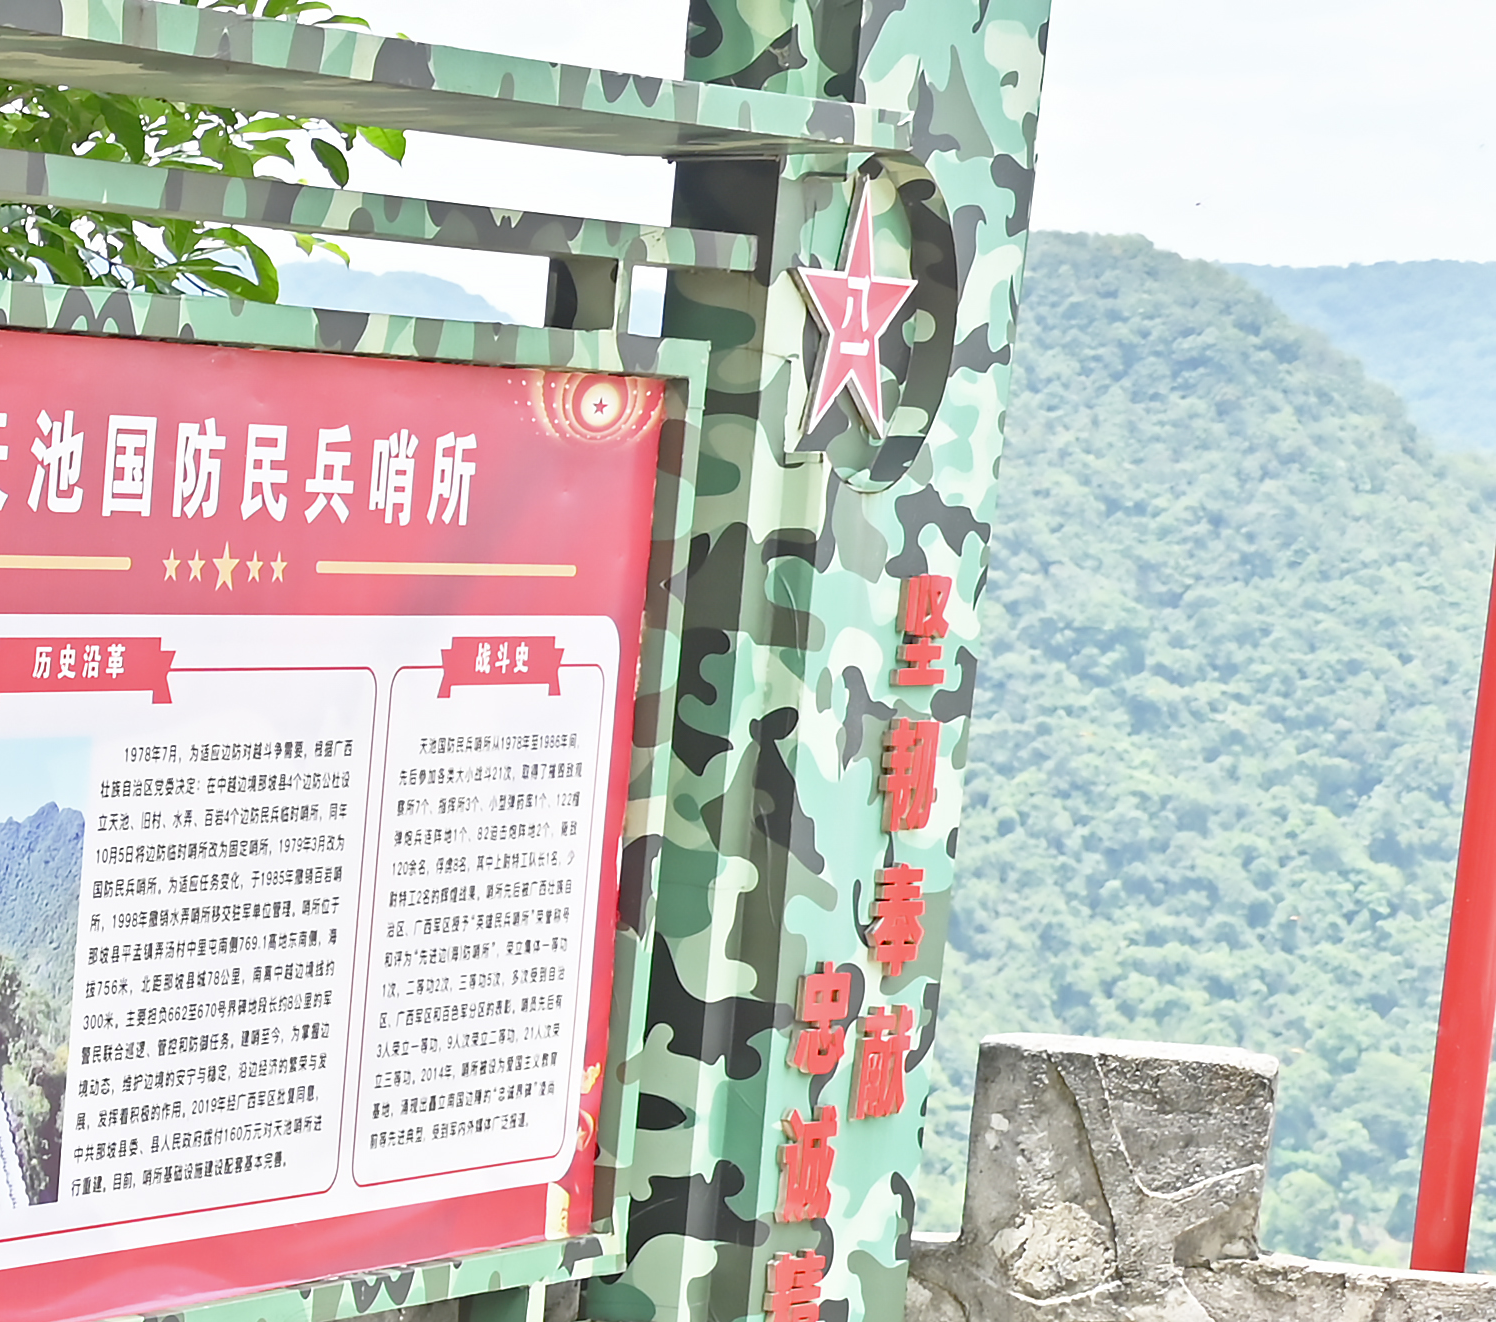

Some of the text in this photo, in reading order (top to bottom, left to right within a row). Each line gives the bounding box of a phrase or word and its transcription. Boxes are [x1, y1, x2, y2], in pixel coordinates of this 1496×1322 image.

[839, 274, 871, 357] 八一
[32, 643, 126, 679] 历史沿革
[475, 641, 529, 674] 战斗史
[848, 574, 953, 1122] 坚韧奉献
